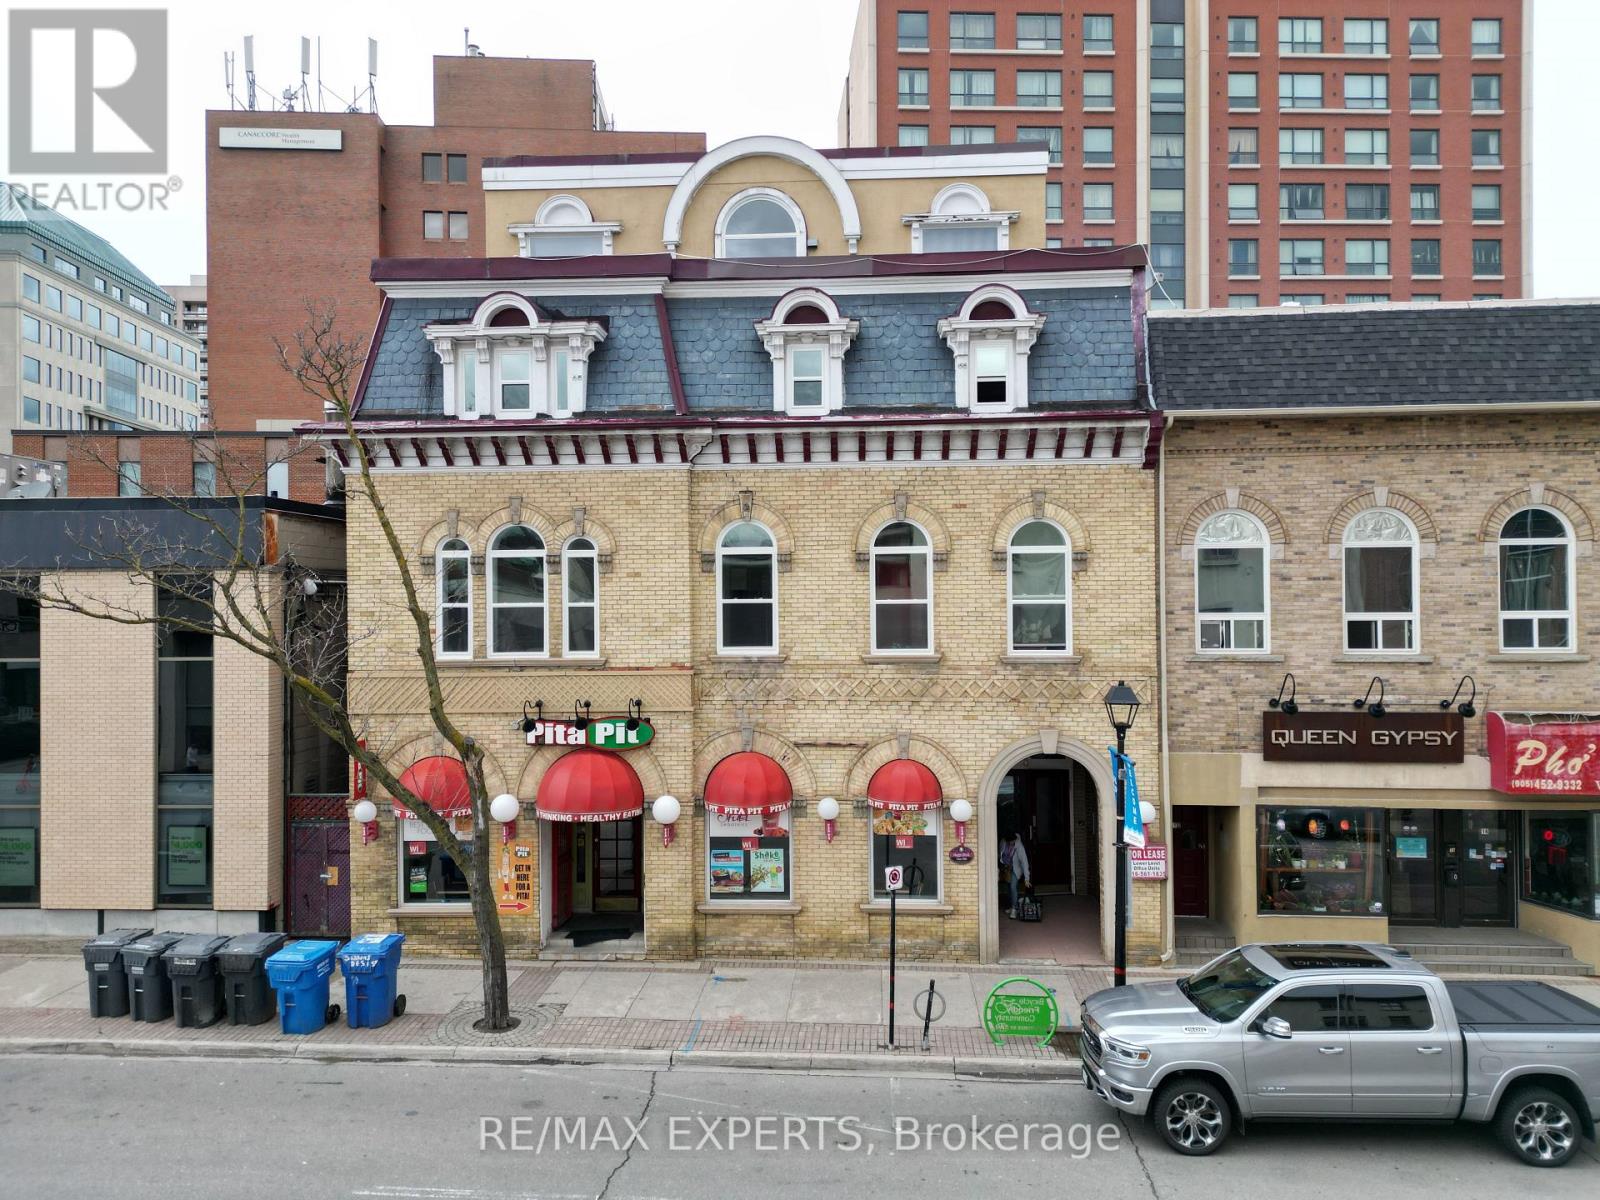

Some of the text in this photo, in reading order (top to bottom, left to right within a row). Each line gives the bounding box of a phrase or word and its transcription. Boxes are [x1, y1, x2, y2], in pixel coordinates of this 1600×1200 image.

[524, 722, 640, 745] Pita Pit
[1271, 729, 1458, 747] QUEEN GYPSY
[451, 807, 472, 818] PITA
[724, 807, 746, 815] PITA
[769, 804, 786, 813] PITA
[539, 811, 573, 822] THINKING
[579, 813, 621, 823] HEALTHY
[1132, 850, 1166, 859] OR LEASE
[516, 873, 529, 881] HERE
